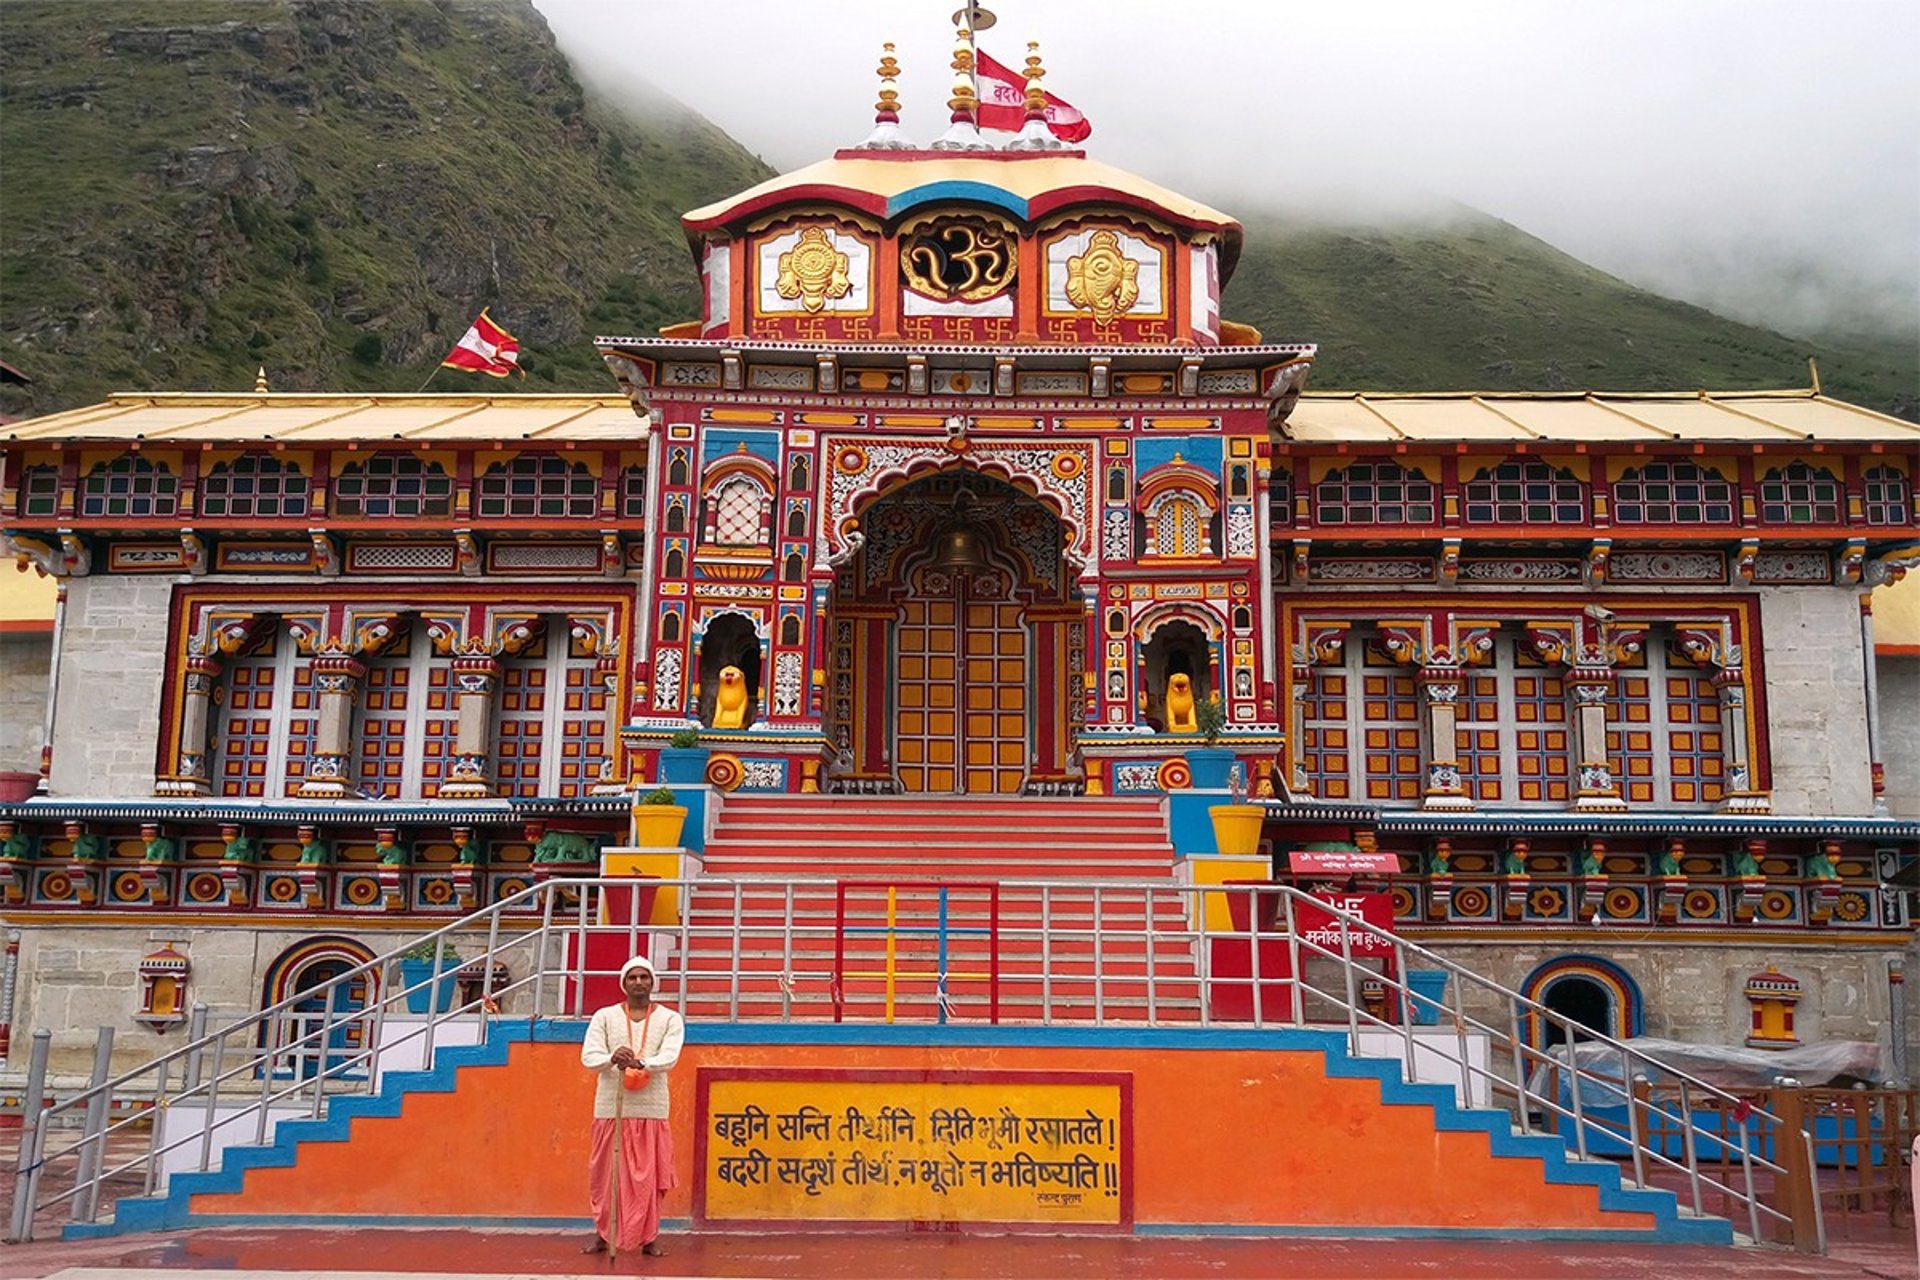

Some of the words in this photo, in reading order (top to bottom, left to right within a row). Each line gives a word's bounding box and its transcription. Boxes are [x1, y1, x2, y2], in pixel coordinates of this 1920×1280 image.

[776, 1106, 831, 1141] सन्ति
[718, 1148, 771, 1187] बदरी
[777, 1151, 836, 1196] सदृशं
[920, 1151, 965, 1196] भूतो
[969, 1161, 987, 1187] न
[991, 1152, 1100, 1188] भविष्यति
